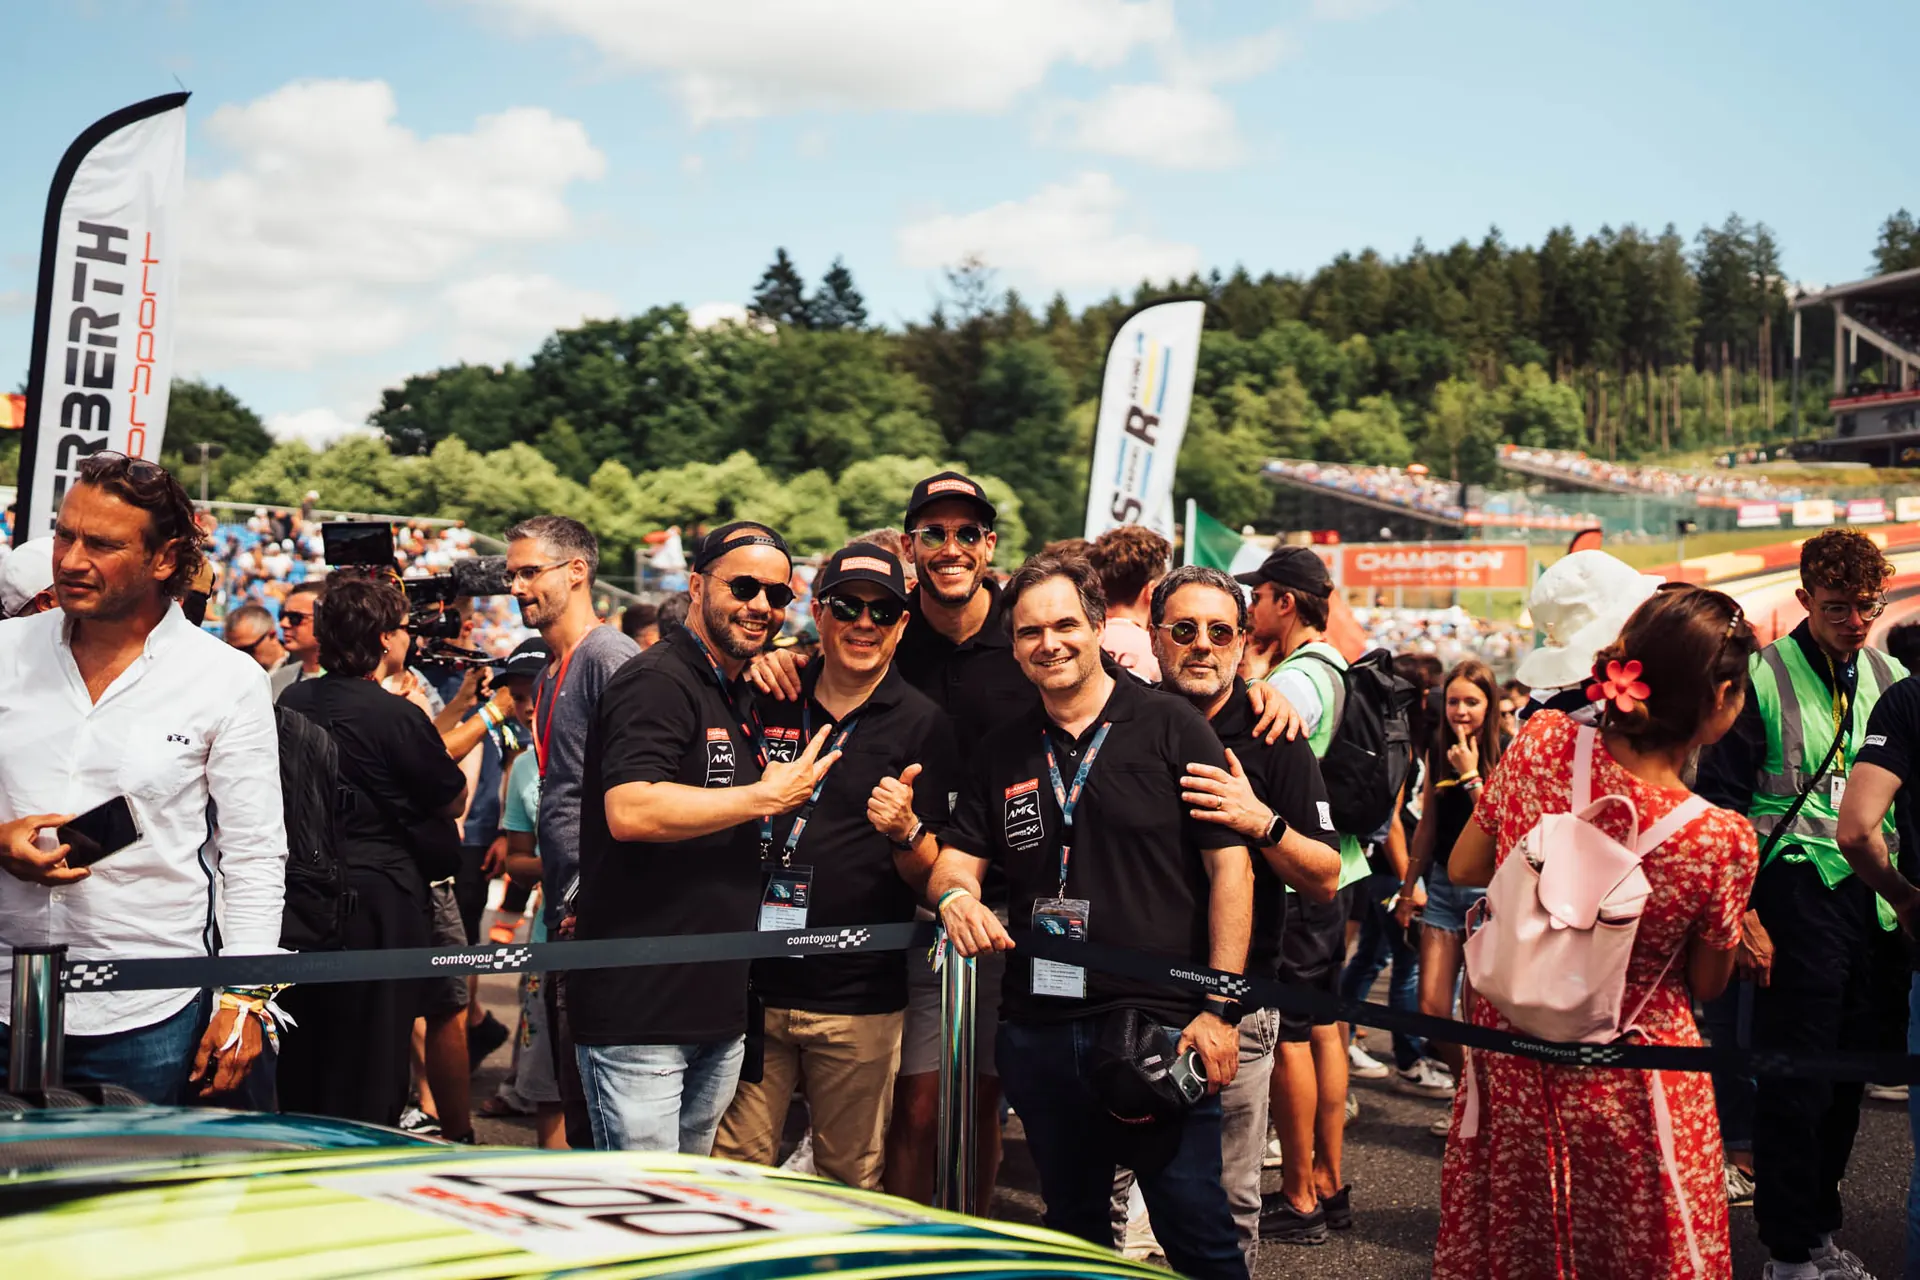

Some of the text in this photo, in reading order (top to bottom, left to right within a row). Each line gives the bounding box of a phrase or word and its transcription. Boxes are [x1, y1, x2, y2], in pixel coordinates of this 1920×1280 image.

[1355, 551, 1504, 571] CHAMPION
[711, 754, 734, 767] AMR
[1007, 803, 1037, 820] AMR
[787, 934, 838, 946] comtoyou
[431, 953, 492, 966] comtoyou
[1170, 968, 1218, 985] comtoyou
[1512, 1040, 1577, 1057] comtoyou
